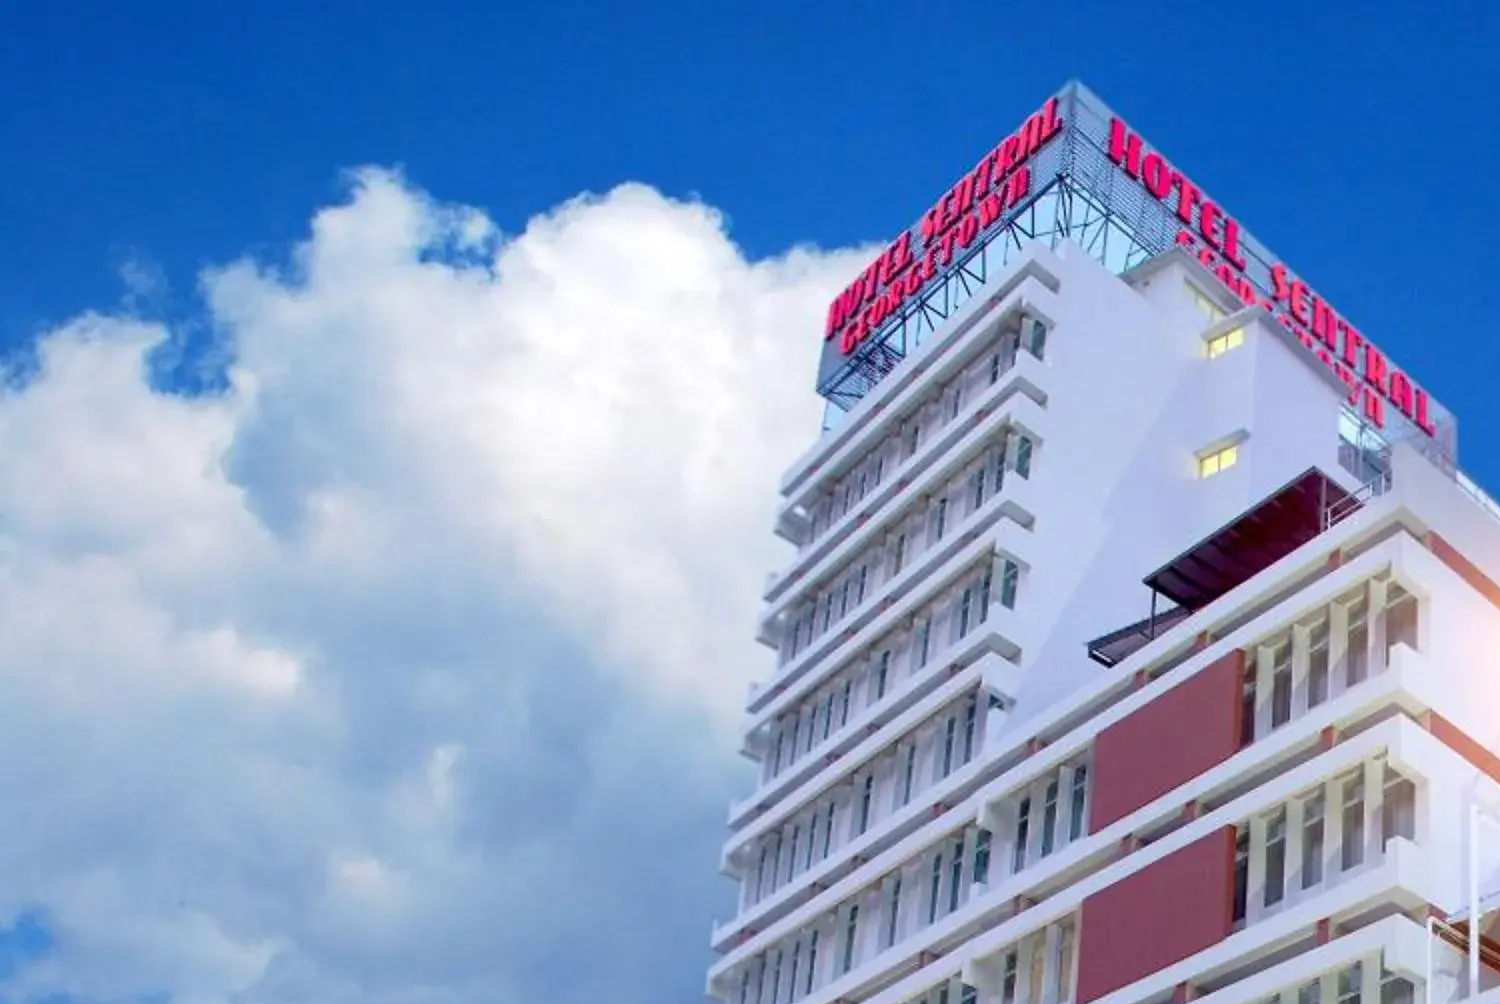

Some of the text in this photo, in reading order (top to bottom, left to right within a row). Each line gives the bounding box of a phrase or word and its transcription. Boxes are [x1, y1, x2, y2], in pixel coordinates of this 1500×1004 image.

[826, 96, 1063, 342] HOTEL SENTRAL
[840, 166, 1031, 356] GEORGETOWN
[1107, 116, 1437, 438] HOTEL SENTRAL
